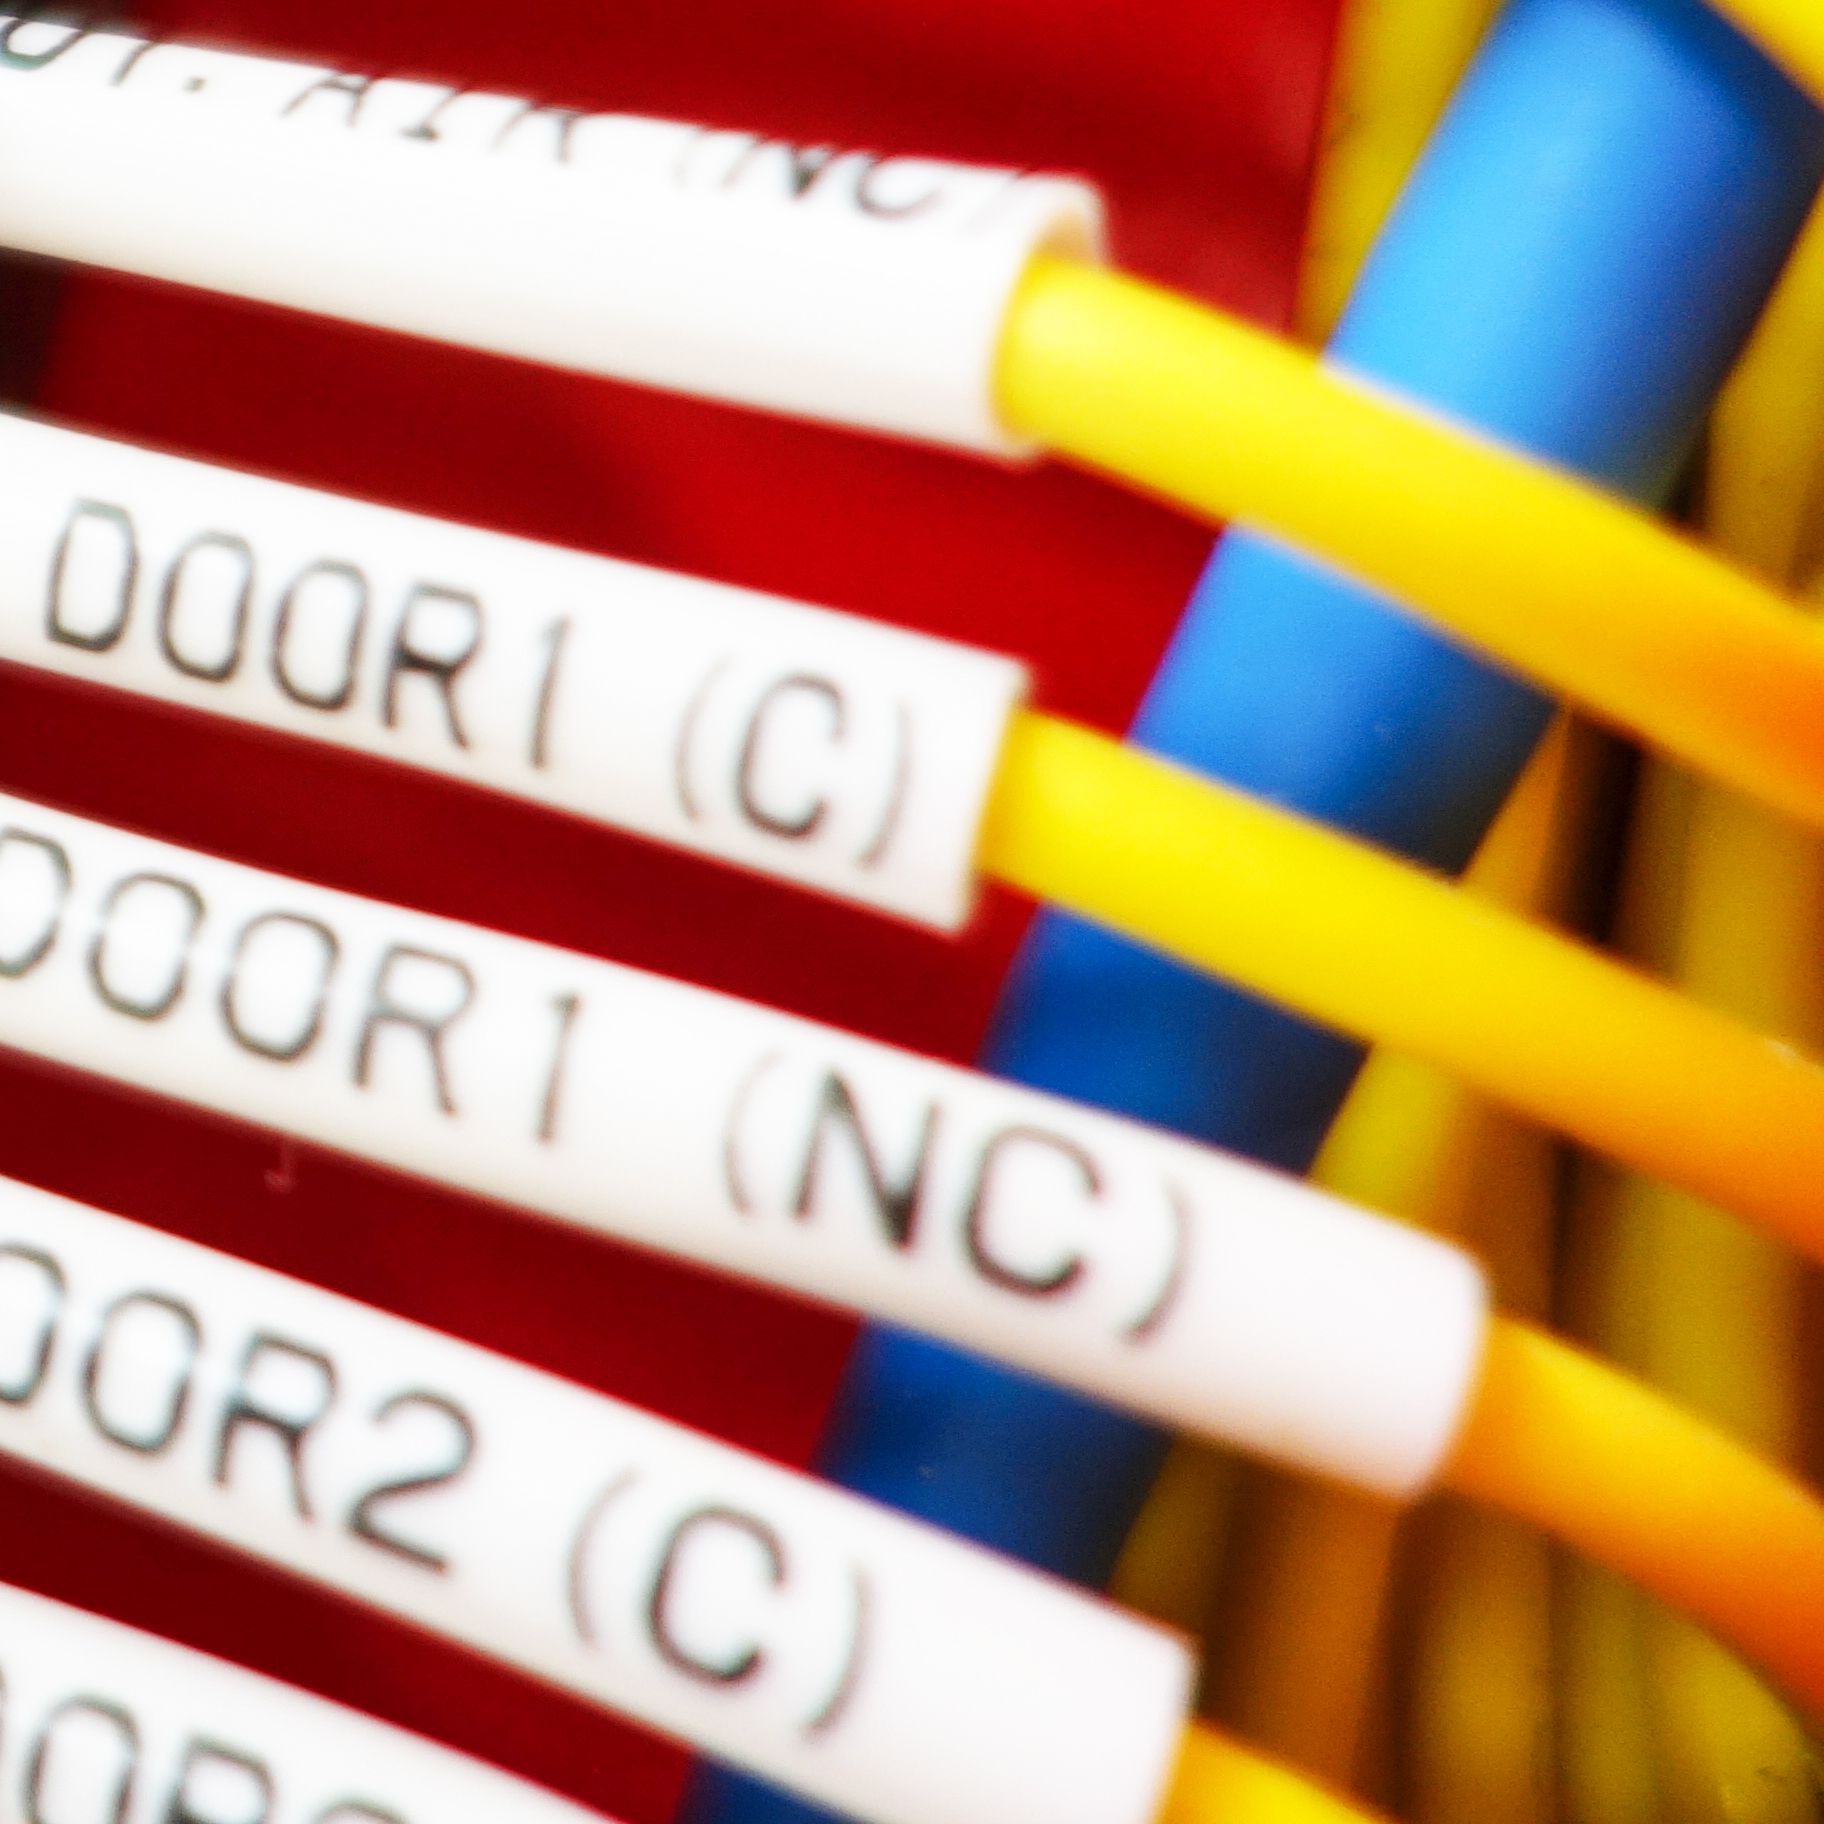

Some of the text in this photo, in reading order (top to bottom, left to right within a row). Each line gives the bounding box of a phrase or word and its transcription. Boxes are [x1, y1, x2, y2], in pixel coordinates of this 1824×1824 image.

[42, 496, 574, 774] DOOR1
[675, 654, 914, 872] (C)
[720, 1051, 1198, 1344] (NC)
[566, 1469, 879, 1741] (C)
